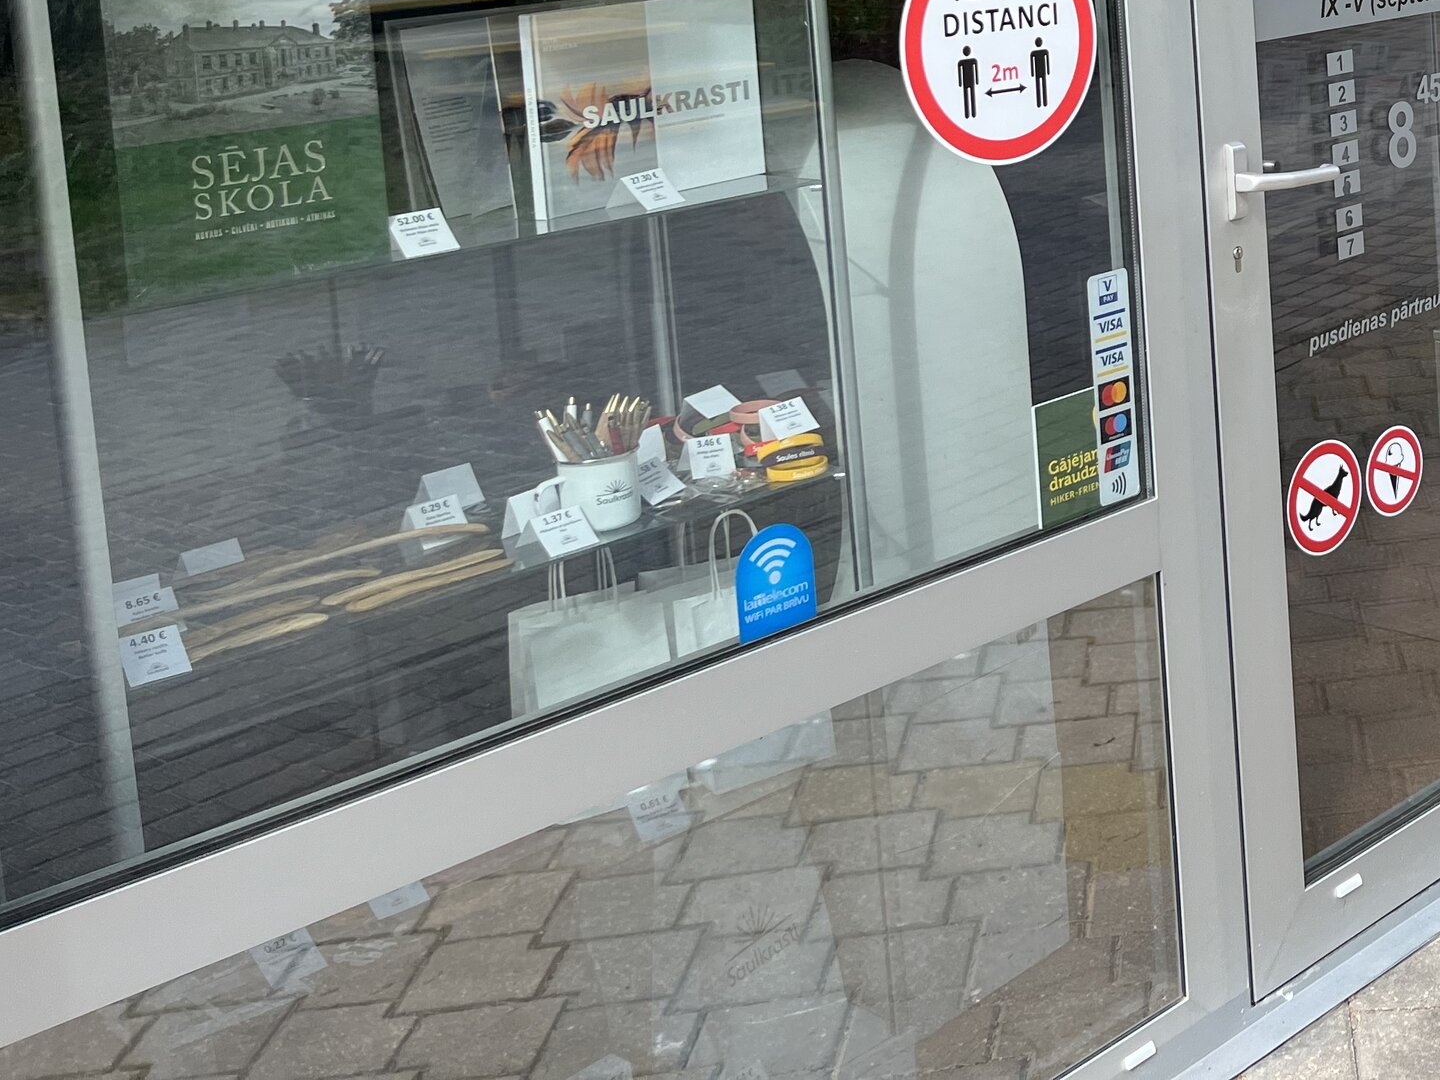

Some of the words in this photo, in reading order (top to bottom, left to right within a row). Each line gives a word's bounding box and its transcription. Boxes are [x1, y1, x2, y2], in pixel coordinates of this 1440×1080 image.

[943, 2, 1058, 37] DISTANCI
[991, 64, 1019, 82] 2m
[582, 79, 750, 129] SAULKRASTI
[1388, 101, 1417, 169] 8
[191, 139, 327, 190] SĒJAS
[194, 175, 334, 220] SKOLA
[396, 214, 425, 226] 52.00
[1102, 279, 1112, 292] V
[1103, 294, 1114, 303] PAY
[1098, 317, 1123, 333] VISA
[1309, 310, 1387, 357] pusdienas
[1100, 351, 1124, 367] VISA
[696, 438, 715, 448] 3.46
[1049, 465, 1099, 492] draudz
[421, 502, 441, 514] 6.29
[542, 513, 562, 526] 1.37
[125, 595, 150, 610] 8.65
[153, 592, 161, 602] €
[765, 604, 782, 616] PAR
[129, 633, 156, 647] 4.40
[159, 630, 167, 640] €
